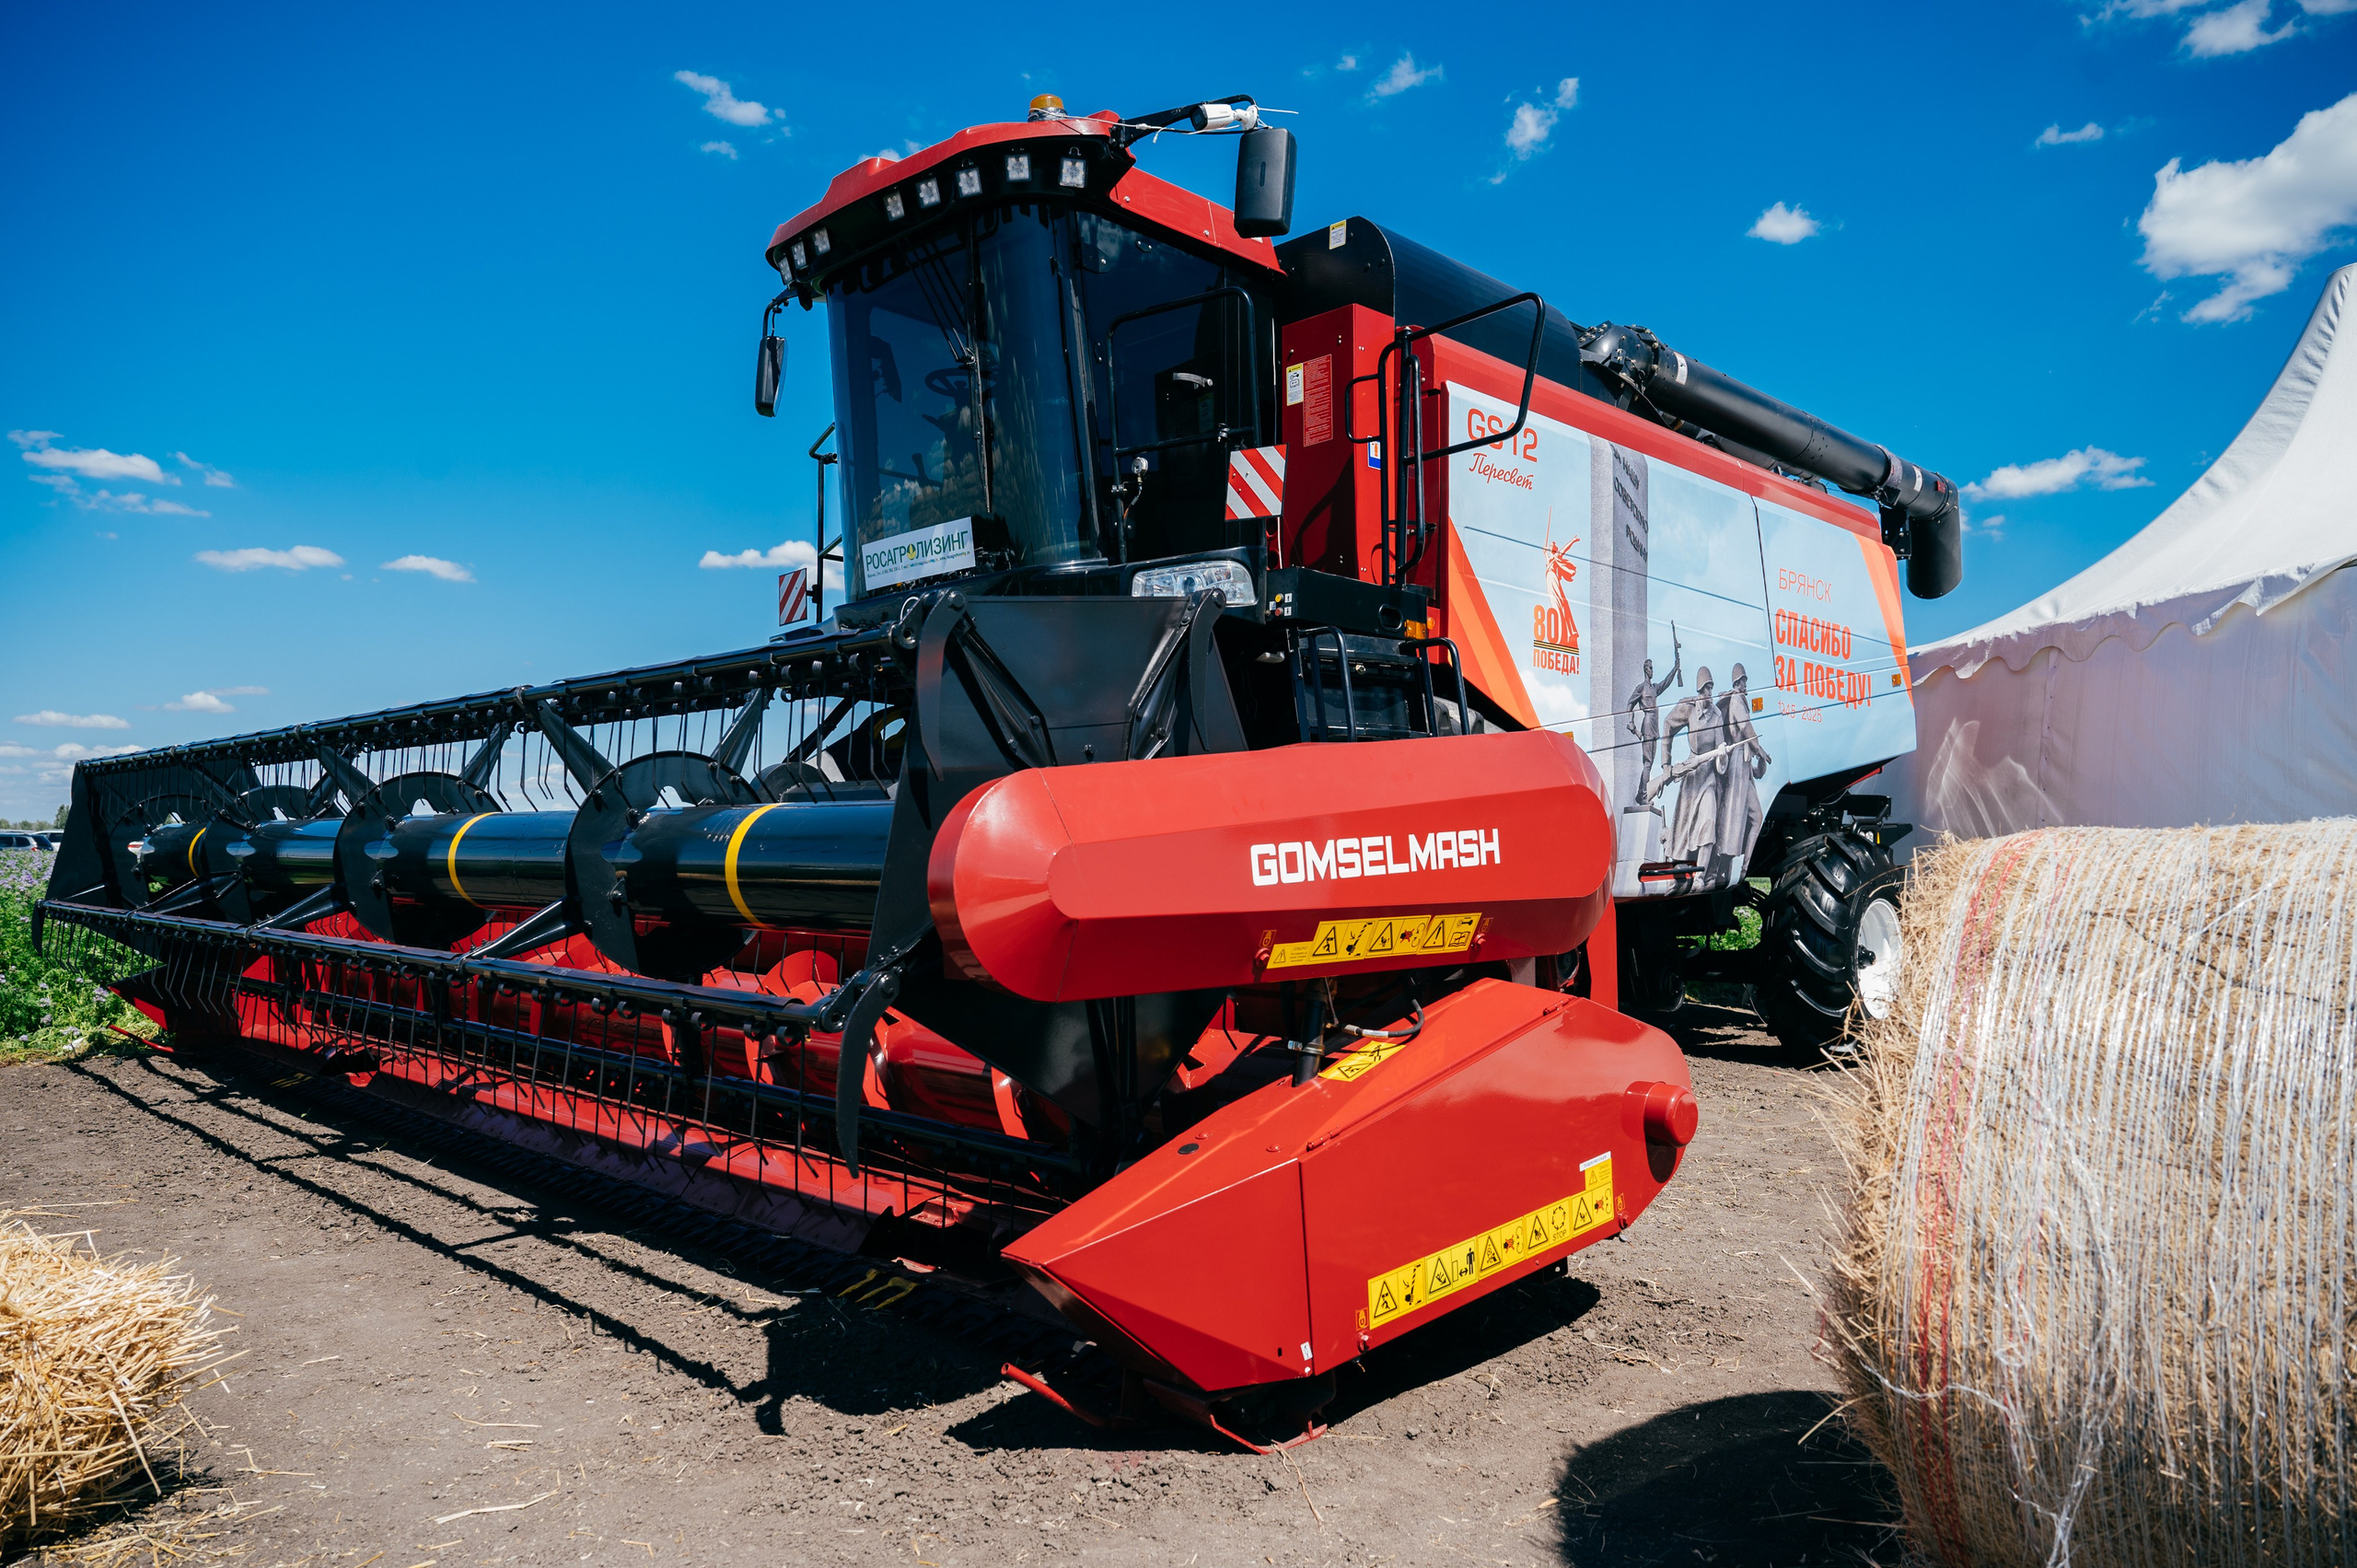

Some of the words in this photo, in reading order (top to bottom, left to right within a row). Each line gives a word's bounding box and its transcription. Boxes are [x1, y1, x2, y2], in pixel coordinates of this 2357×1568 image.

[1469, 452, 1534, 490] Пересвет
[865, 530, 969, 572] РОСАГРОЛИЗИНГ
[1779, 568, 1832, 603] БРЯНСК
[1533, 604, 1559, 644] 80
[1775, 608, 1852, 660] СПАСИБО
[1533, 648, 1579, 676] ПОБЕДА!
[1775, 655, 1798, 693] ЗА
[1804, 661, 1872, 710] ПОБЕДУ!
[1250, 828, 1501, 887] GOMSELMASH
[1552, 1229, 1567, 1241] STOP
